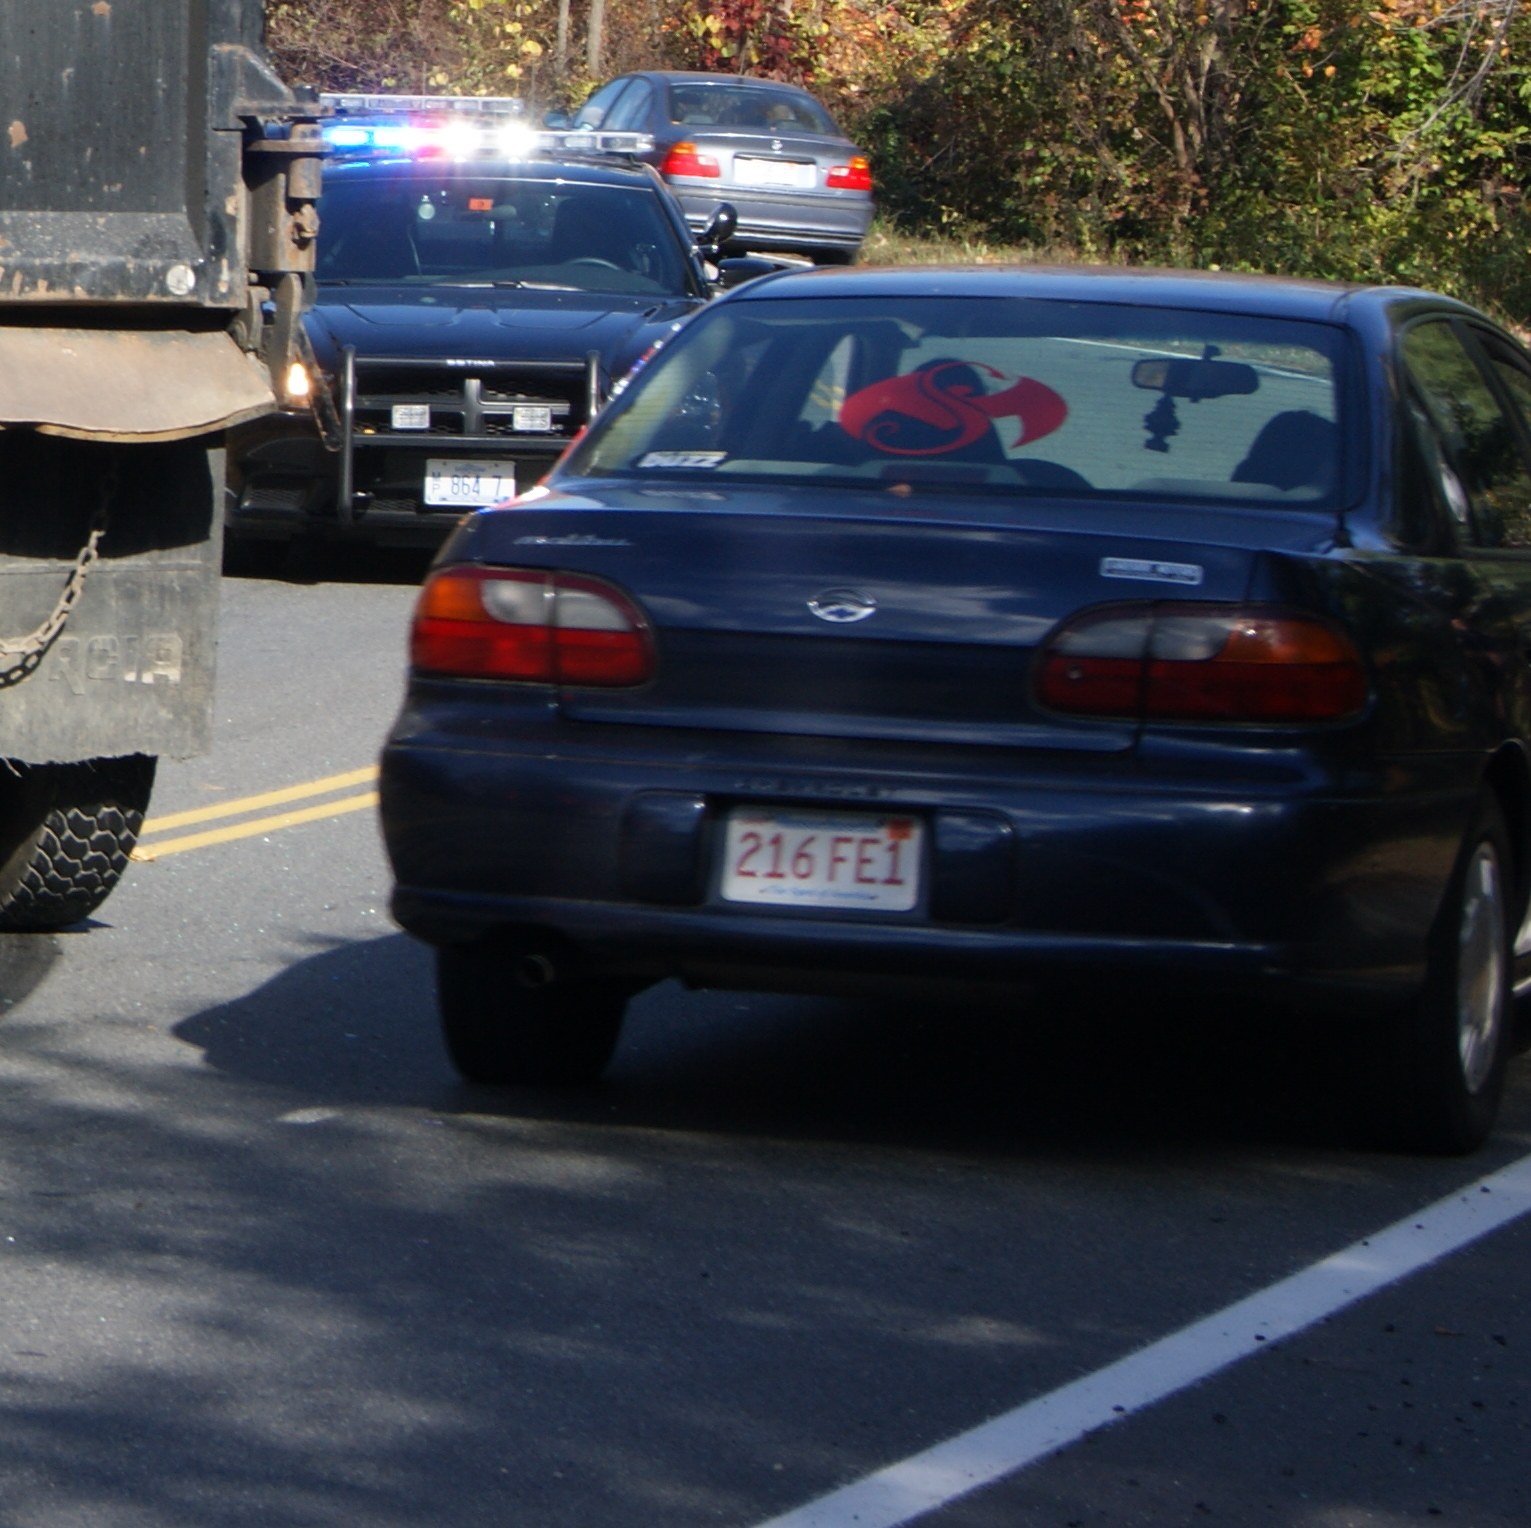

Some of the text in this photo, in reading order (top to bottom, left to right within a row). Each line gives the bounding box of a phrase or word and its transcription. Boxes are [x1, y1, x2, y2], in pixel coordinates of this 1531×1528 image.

[451, 474, 503, 497] 864 7
[736, 831, 902, 885] 216 FE1
